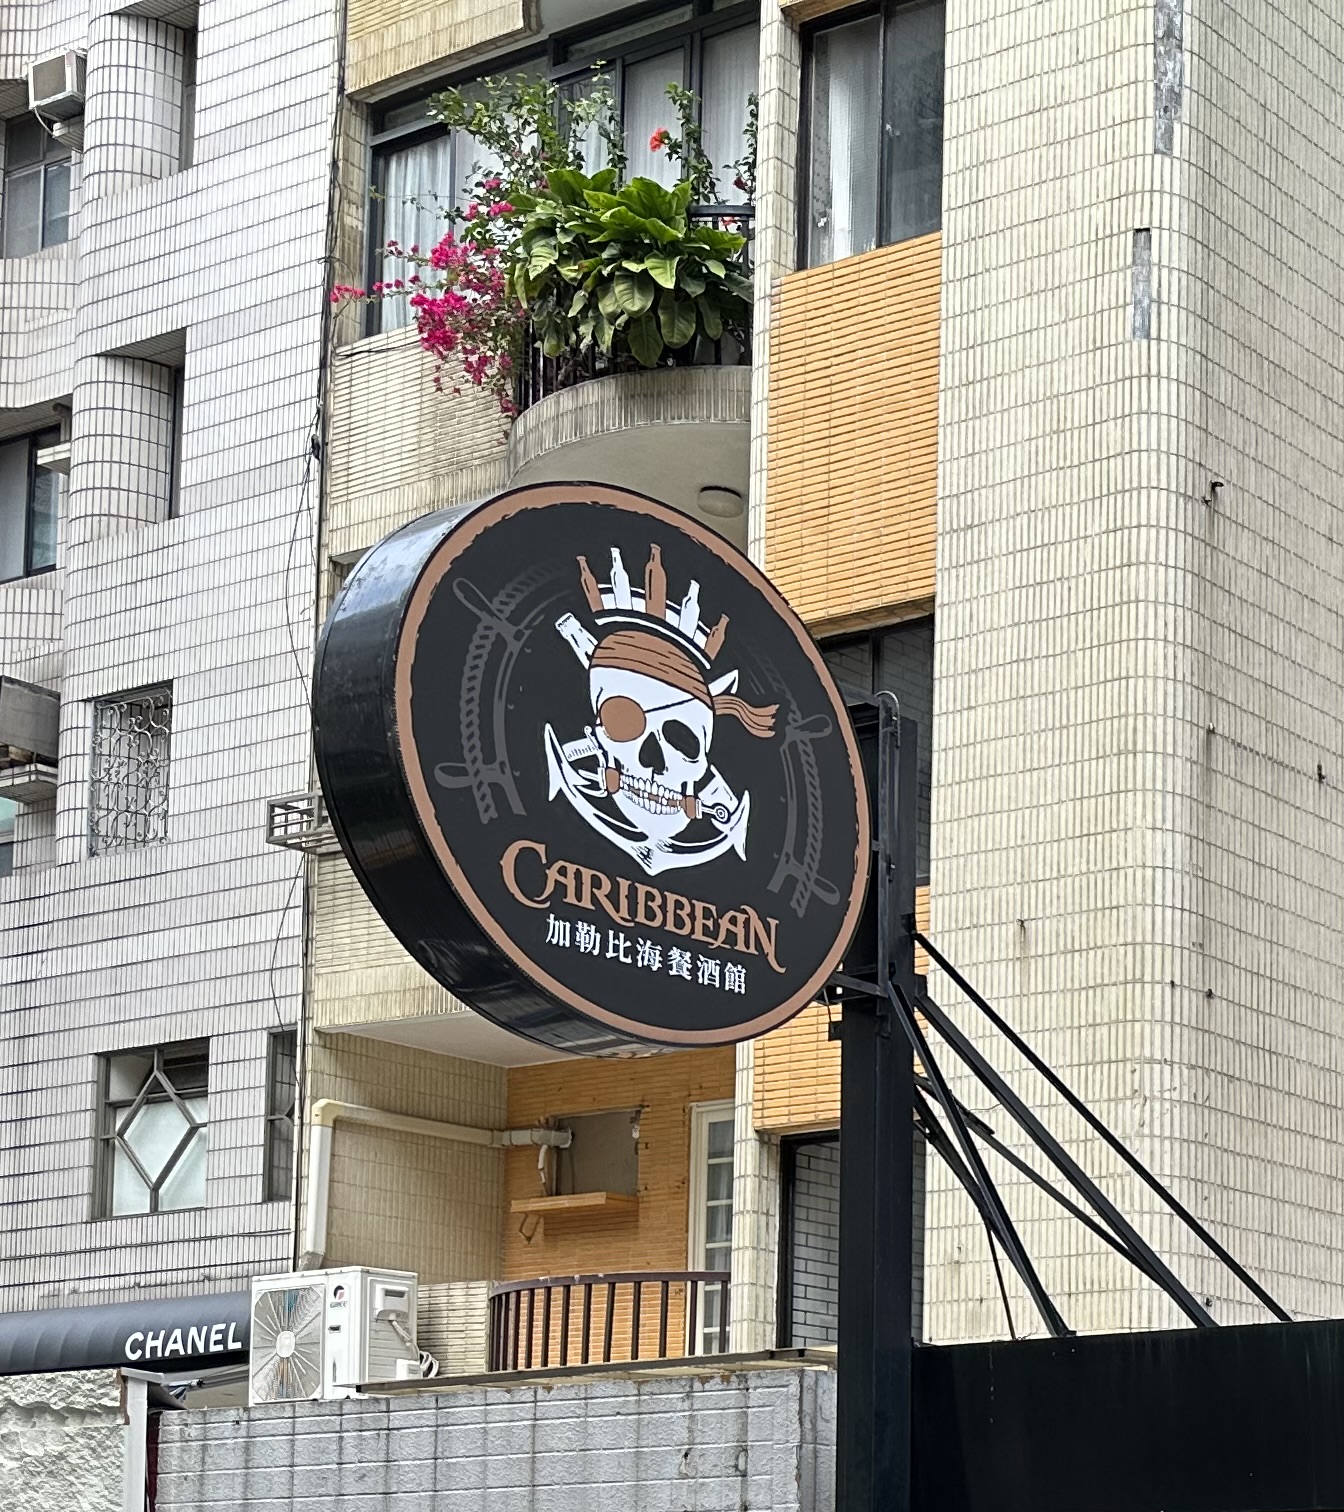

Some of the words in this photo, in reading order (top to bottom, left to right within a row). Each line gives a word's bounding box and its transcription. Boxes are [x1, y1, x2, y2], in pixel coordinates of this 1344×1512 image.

[500, 840, 786, 974] CARIBBEAN
[545, 914, 747, 995] 加勒比海餐酒館
[125, 1322, 242, 1361] CHANEL
